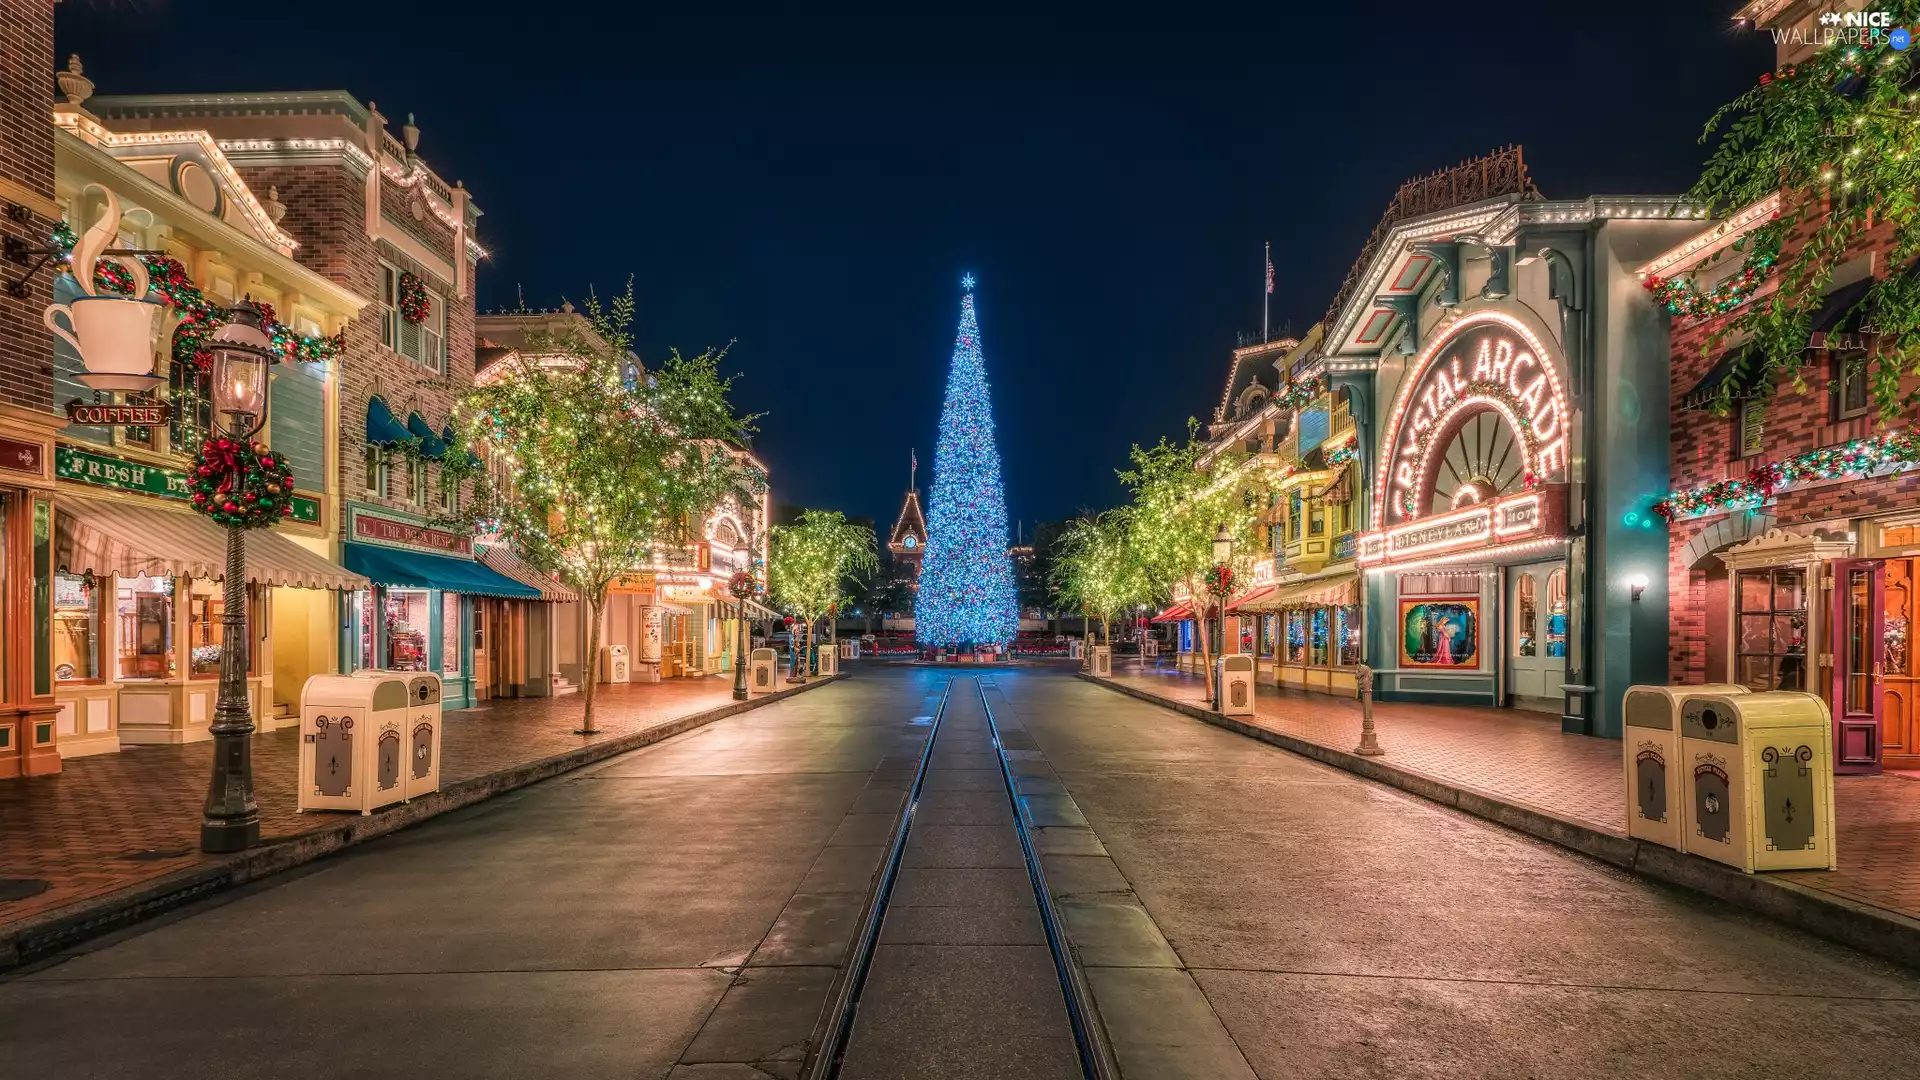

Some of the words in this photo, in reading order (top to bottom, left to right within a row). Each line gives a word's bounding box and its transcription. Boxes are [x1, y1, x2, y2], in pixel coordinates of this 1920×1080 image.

[75, 407, 162, 424] COFFEE
[1393, 356, 1467, 517] CRYSTAL
[1472, 338, 1566, 479] ARCADE
[72, 457, 146, 486] FRESH
[380, 523, 401, 539] THE
[404, 528, 429, 543] BOOK
[431, 533, 450, 548] REST
[1397, 518, 1485, 548] DISNEYLAND
[1512, 509, 1532, 522] 107
